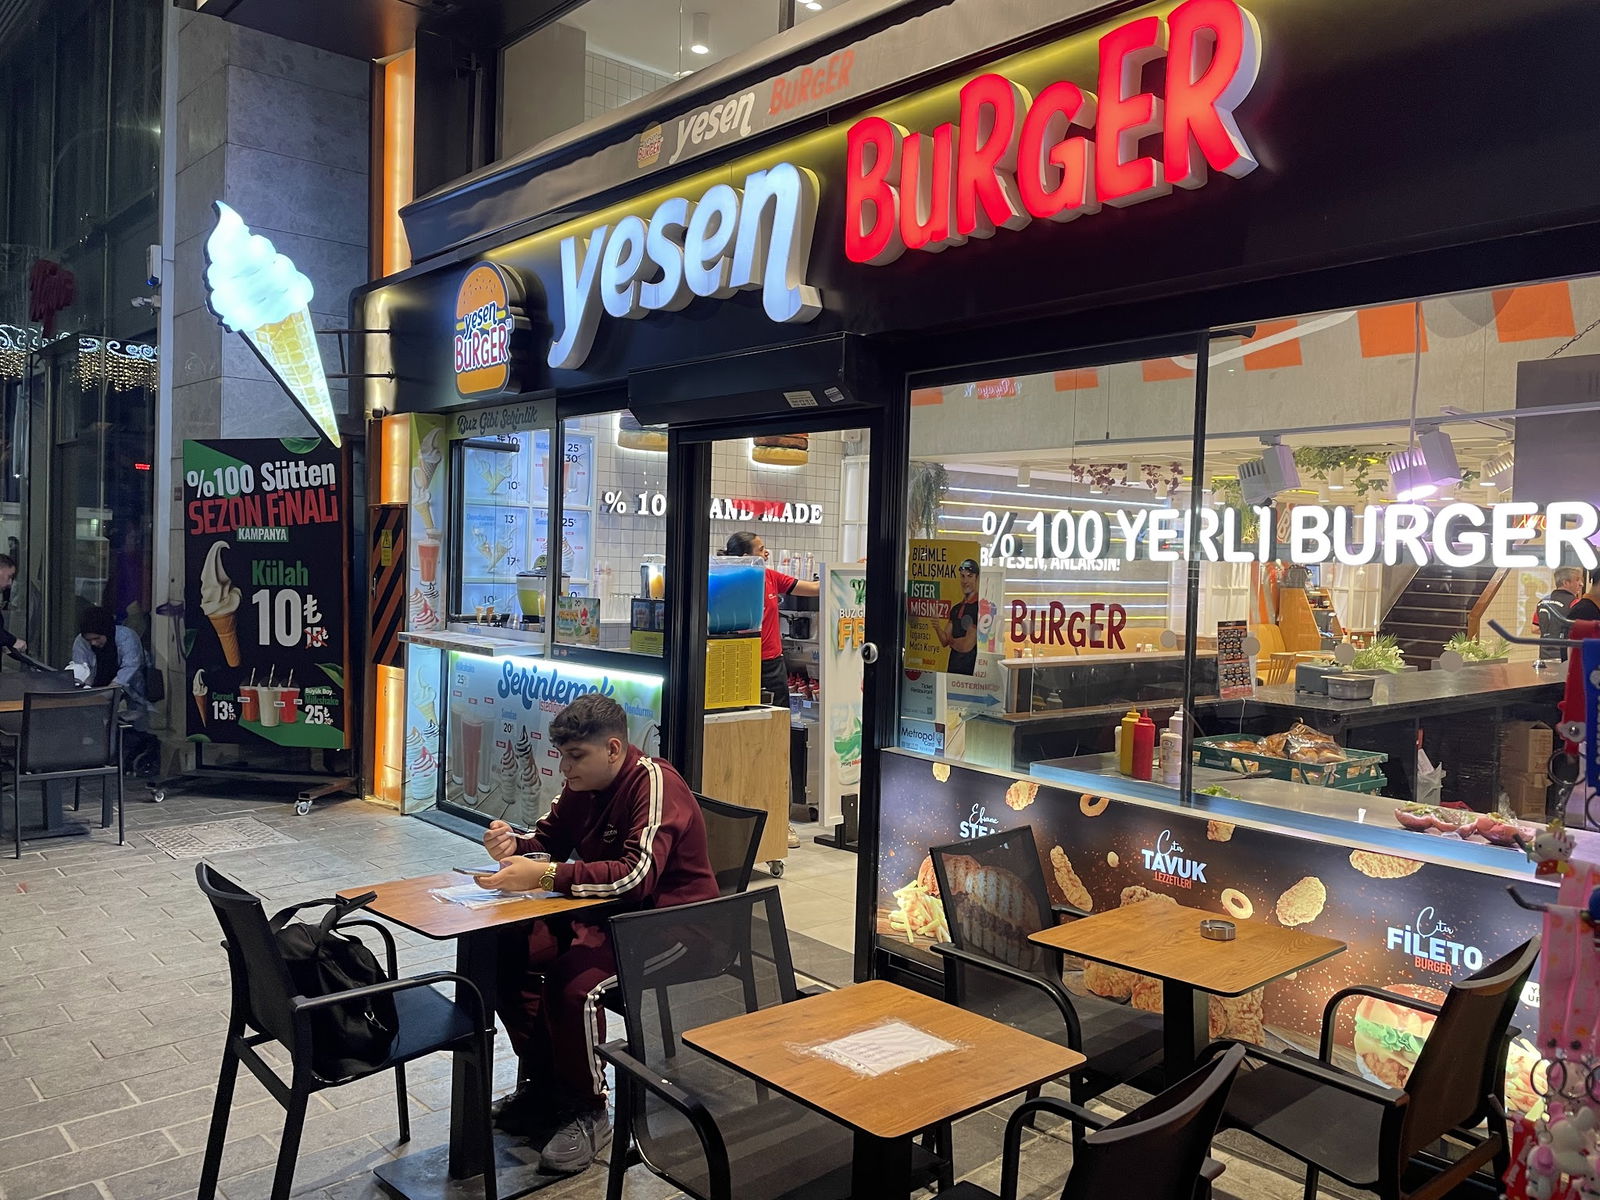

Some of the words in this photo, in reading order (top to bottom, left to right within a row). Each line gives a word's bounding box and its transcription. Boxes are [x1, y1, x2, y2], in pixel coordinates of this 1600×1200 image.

[669, 92, 755, 165] yesen
[547, 162, 806, 369] yesen
[463, 301, 498, 339] yesen
[457, 414, 477, 435] Buz
[480, 411, 498, 435] Gibi
[186, 464, 255, 498] %100
[260, 460, 336, 492] Sütten
[188, 494, 262, 535] SEZON
[238, 528, 287, 541] KAMPANYA
[1026, 509, 1104, 561] 100
[1291, 501, 1599, 570] BURGER
[252, 560, 309, 586] Külah
[911, 563, 957, 581] ÇALIŞMAK
[911, 581, 935, 598] İSTER
[858, 608, 865, 618] G
[901, 727, 936, 742] Metropol
[1141, 849, 1207, 884] TAVUK
[1387, 925, 1483, 970] FİLETO
[1414, 956, 1452, 976] BURGER
